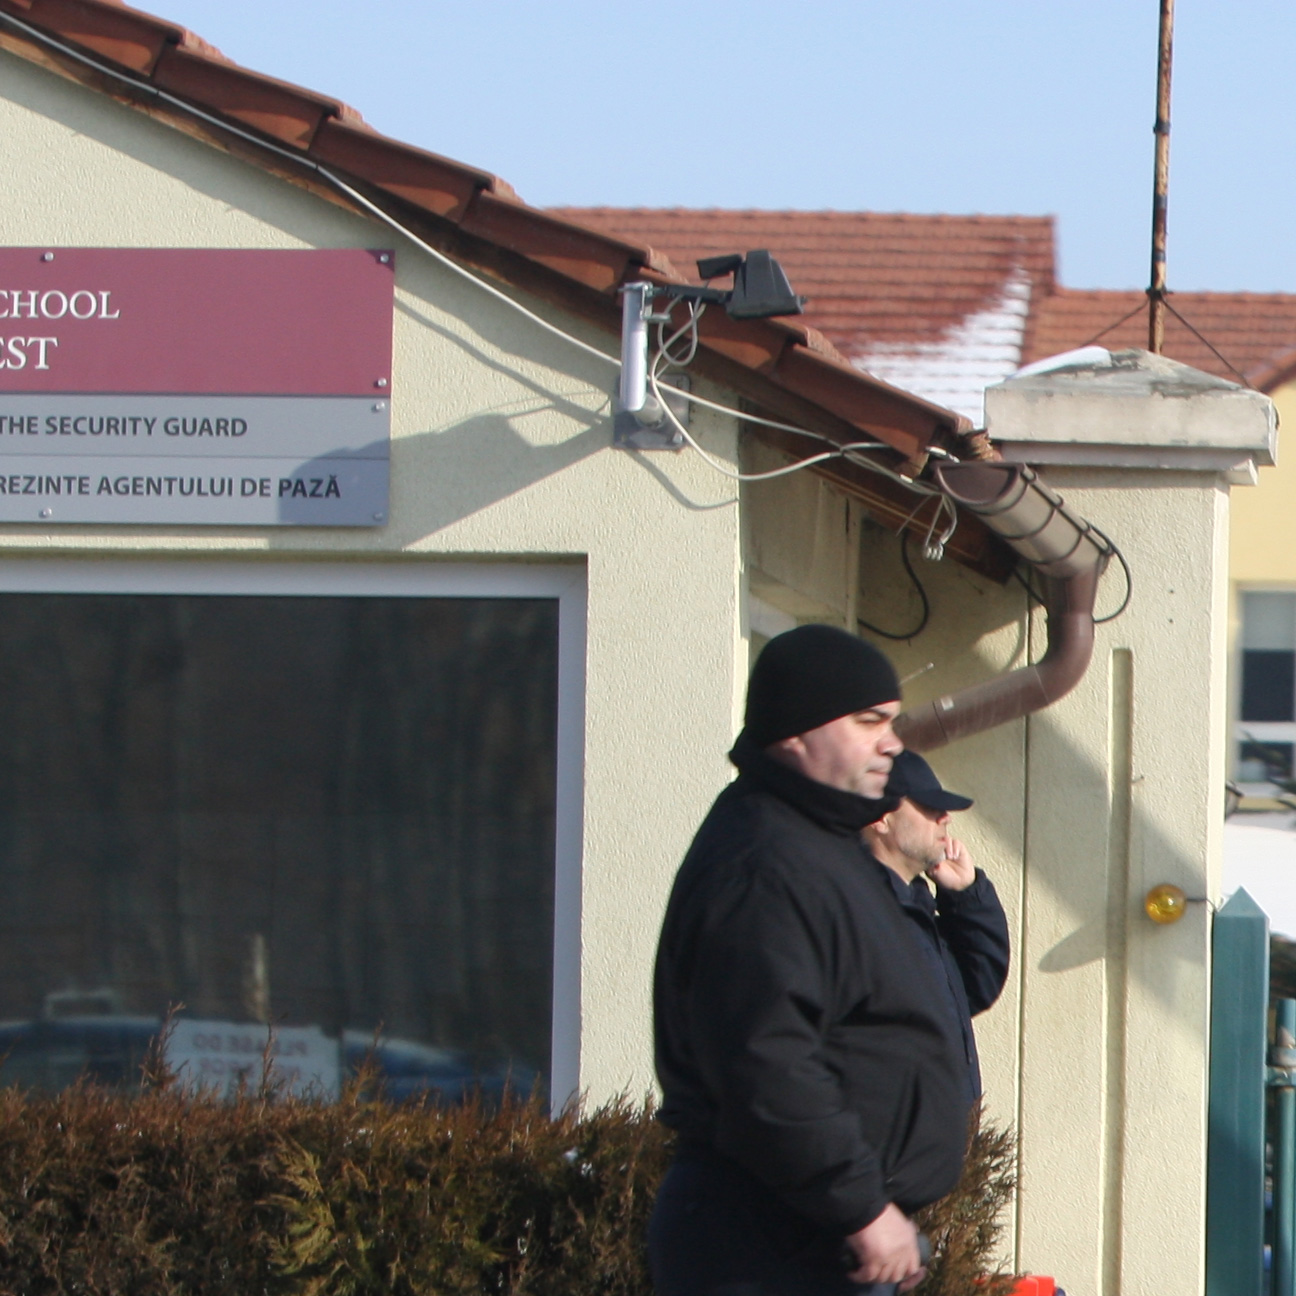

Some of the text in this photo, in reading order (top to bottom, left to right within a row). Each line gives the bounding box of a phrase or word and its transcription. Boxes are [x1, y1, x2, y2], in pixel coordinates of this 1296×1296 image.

[0, 336, 58, 370] ST
[45, 416, 157, 436] SECURITY
[164, 417, 248, 437] GUARD
[97, 476, 233, 497] AGENTULUI
[241, 478, 271, 497] DE
